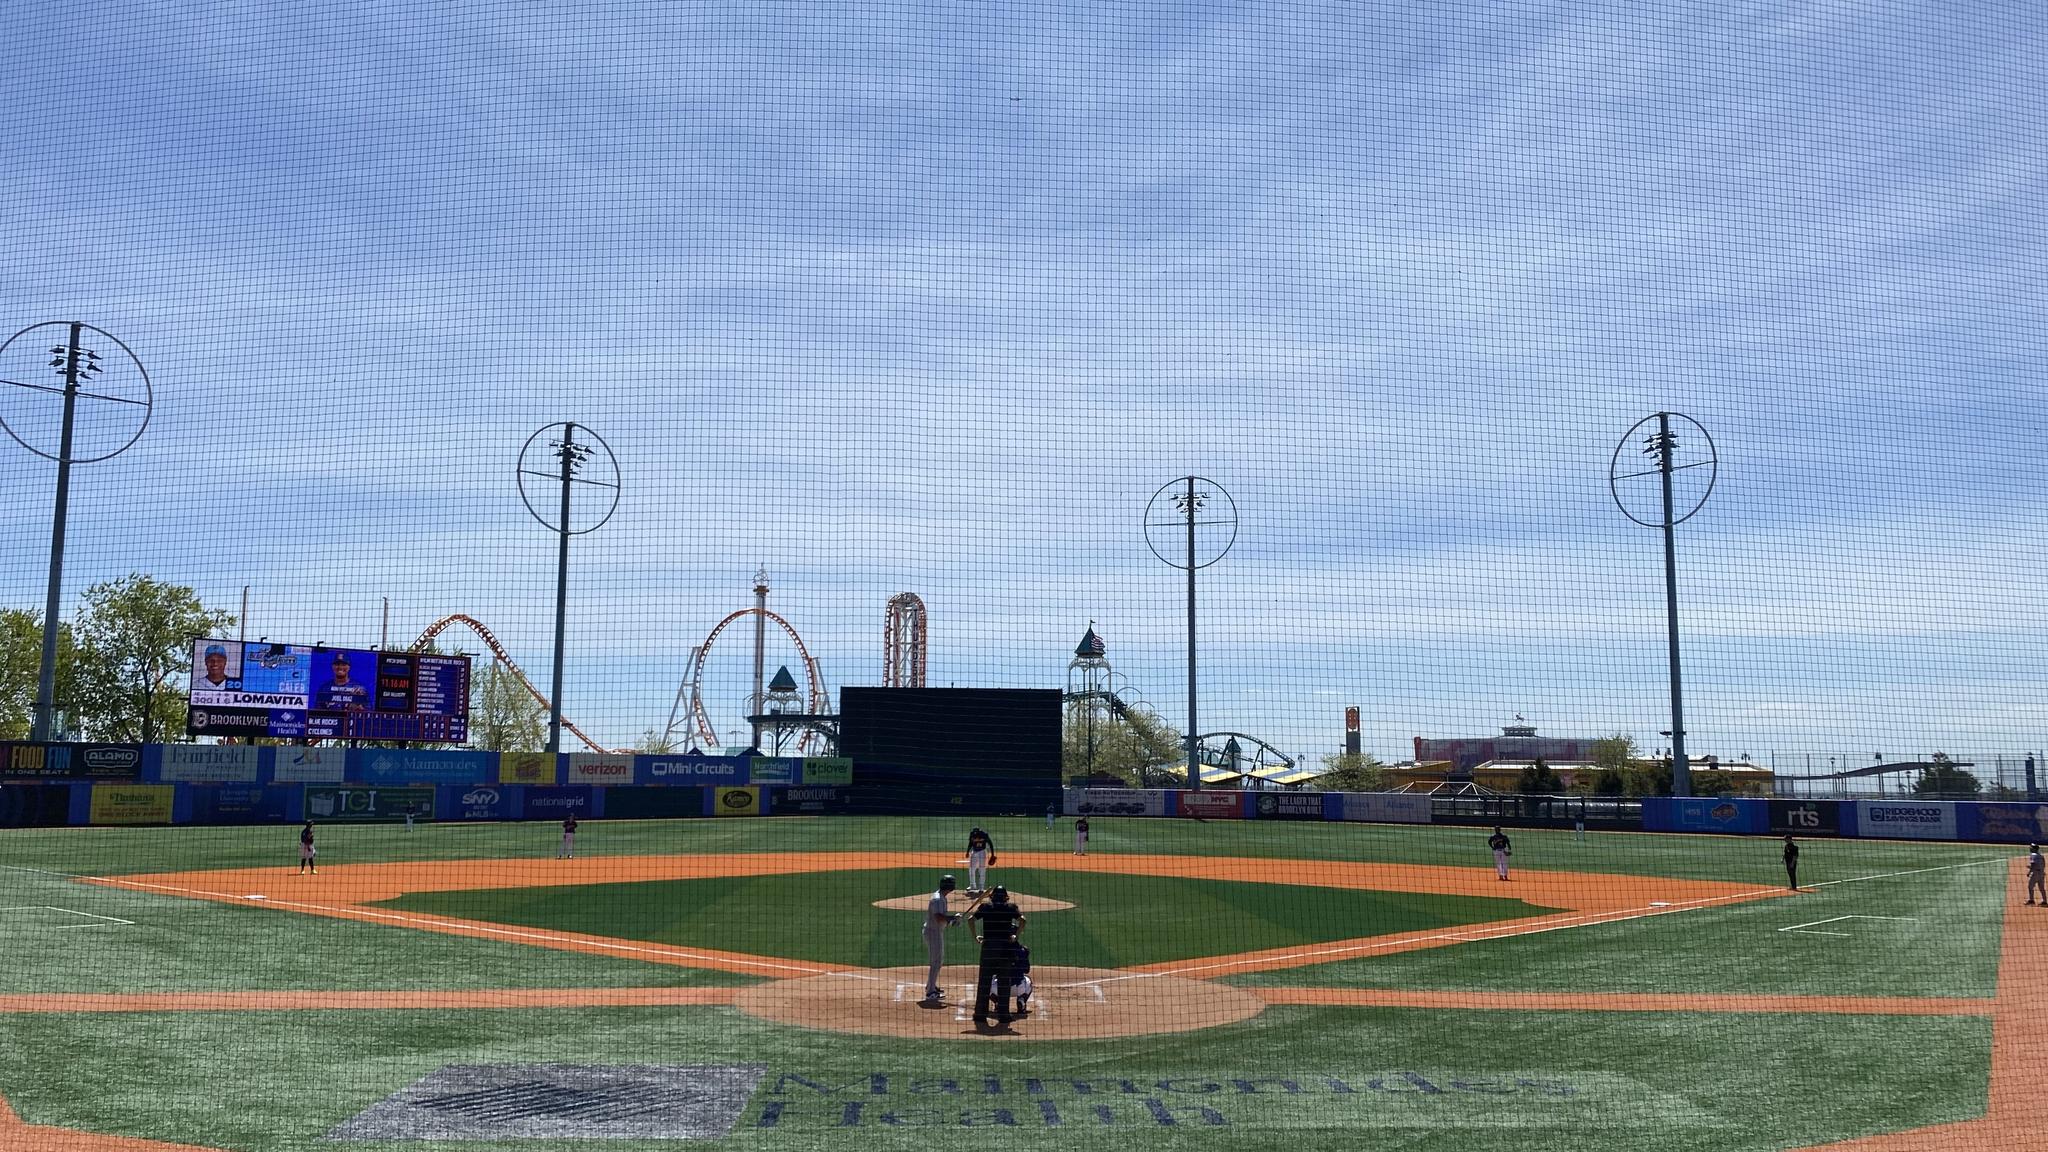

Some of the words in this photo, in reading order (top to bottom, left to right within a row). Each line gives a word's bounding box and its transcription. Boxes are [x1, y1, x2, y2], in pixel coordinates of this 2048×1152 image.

[227, 681, 242, 690] 20
[233, 693, 304, 706] LOMAVITA
[210, 715, 260, 726] BROOKLYN
[308, 717, 322, 725] BLUE
[322, 718, 338, 726] ROCKS
[307, 728, 334, 736] CYCLONES
[11, 745, 46, 769] FOOD
[47, 746, 72, 769] FUN
[88, 751, 134, 761] ALAMO
[578, 761, 627, 776] verizon
[818, 762, 849, 774] clover
[338, 790, 377, 812] TGI
[462, 793, 495, 805] SNY
[787, 789, 829, 801] BROOKLYN
[1279, 796, 1289, 805] THE
[1289, 796, 1308, 805] LAGER
[532, 796, 585, 808] nationalgrid
[1787, 806, 1820, 828] rts
[1885, 815, 1919, 823] SAVINGS
[1919, 816, 1943, 824] BANK
[756, 1100, 1233, 1128] Health
